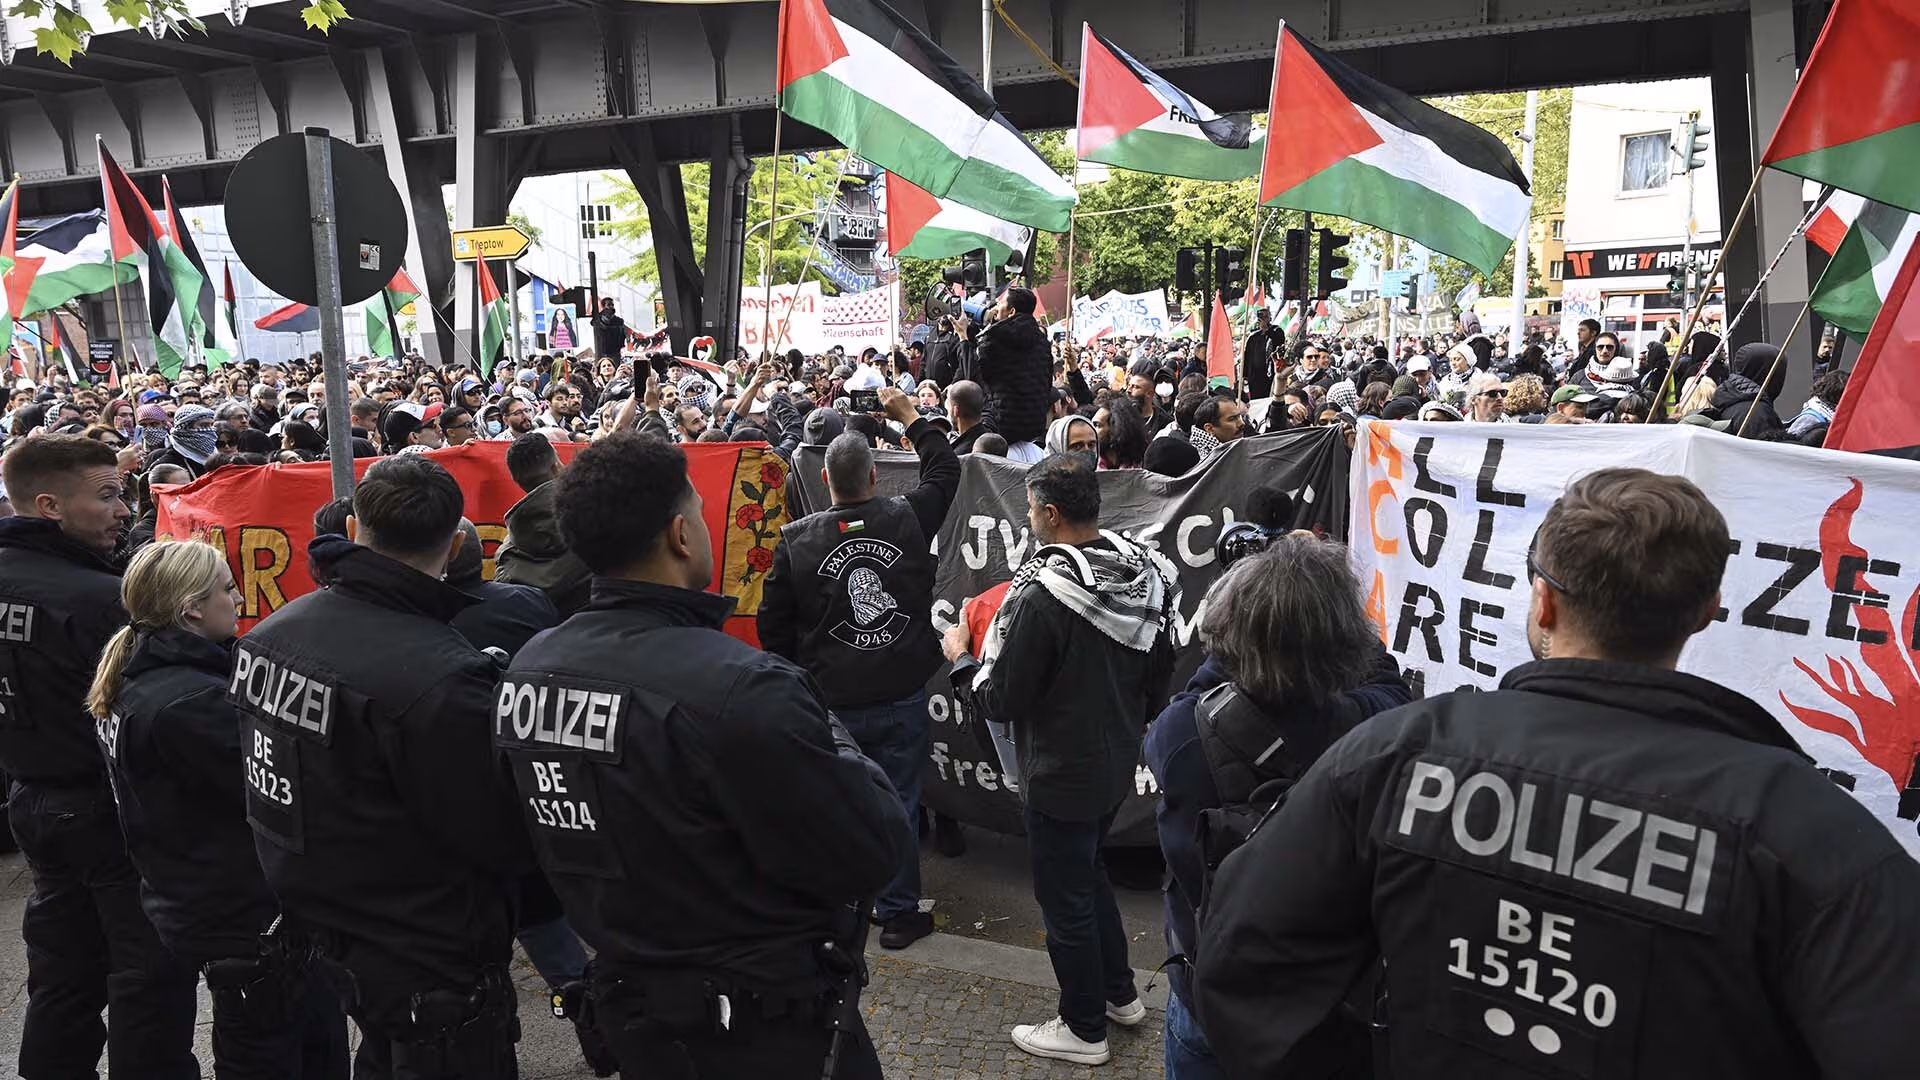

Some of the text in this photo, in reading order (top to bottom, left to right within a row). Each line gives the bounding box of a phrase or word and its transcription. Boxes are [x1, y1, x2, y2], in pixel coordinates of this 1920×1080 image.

[826, 543, 894, 574] PALESTINE
[855, 629, 892, 647] 1948
[230, 648, 333, 736] POLIZEI
[497, 681, 622, 753] POLIZEI
[254, 729, 273, 767] BE
[246, 755, 293, 806] 15123
[532, 761, 568, 793] BE
[529, 796, 596, 831] 15124
[1398, 760, 1718, 916] POLIZEI
[1496, 898, 1576, 961] BE
[1447, 936, 1618, 1029] 15120
